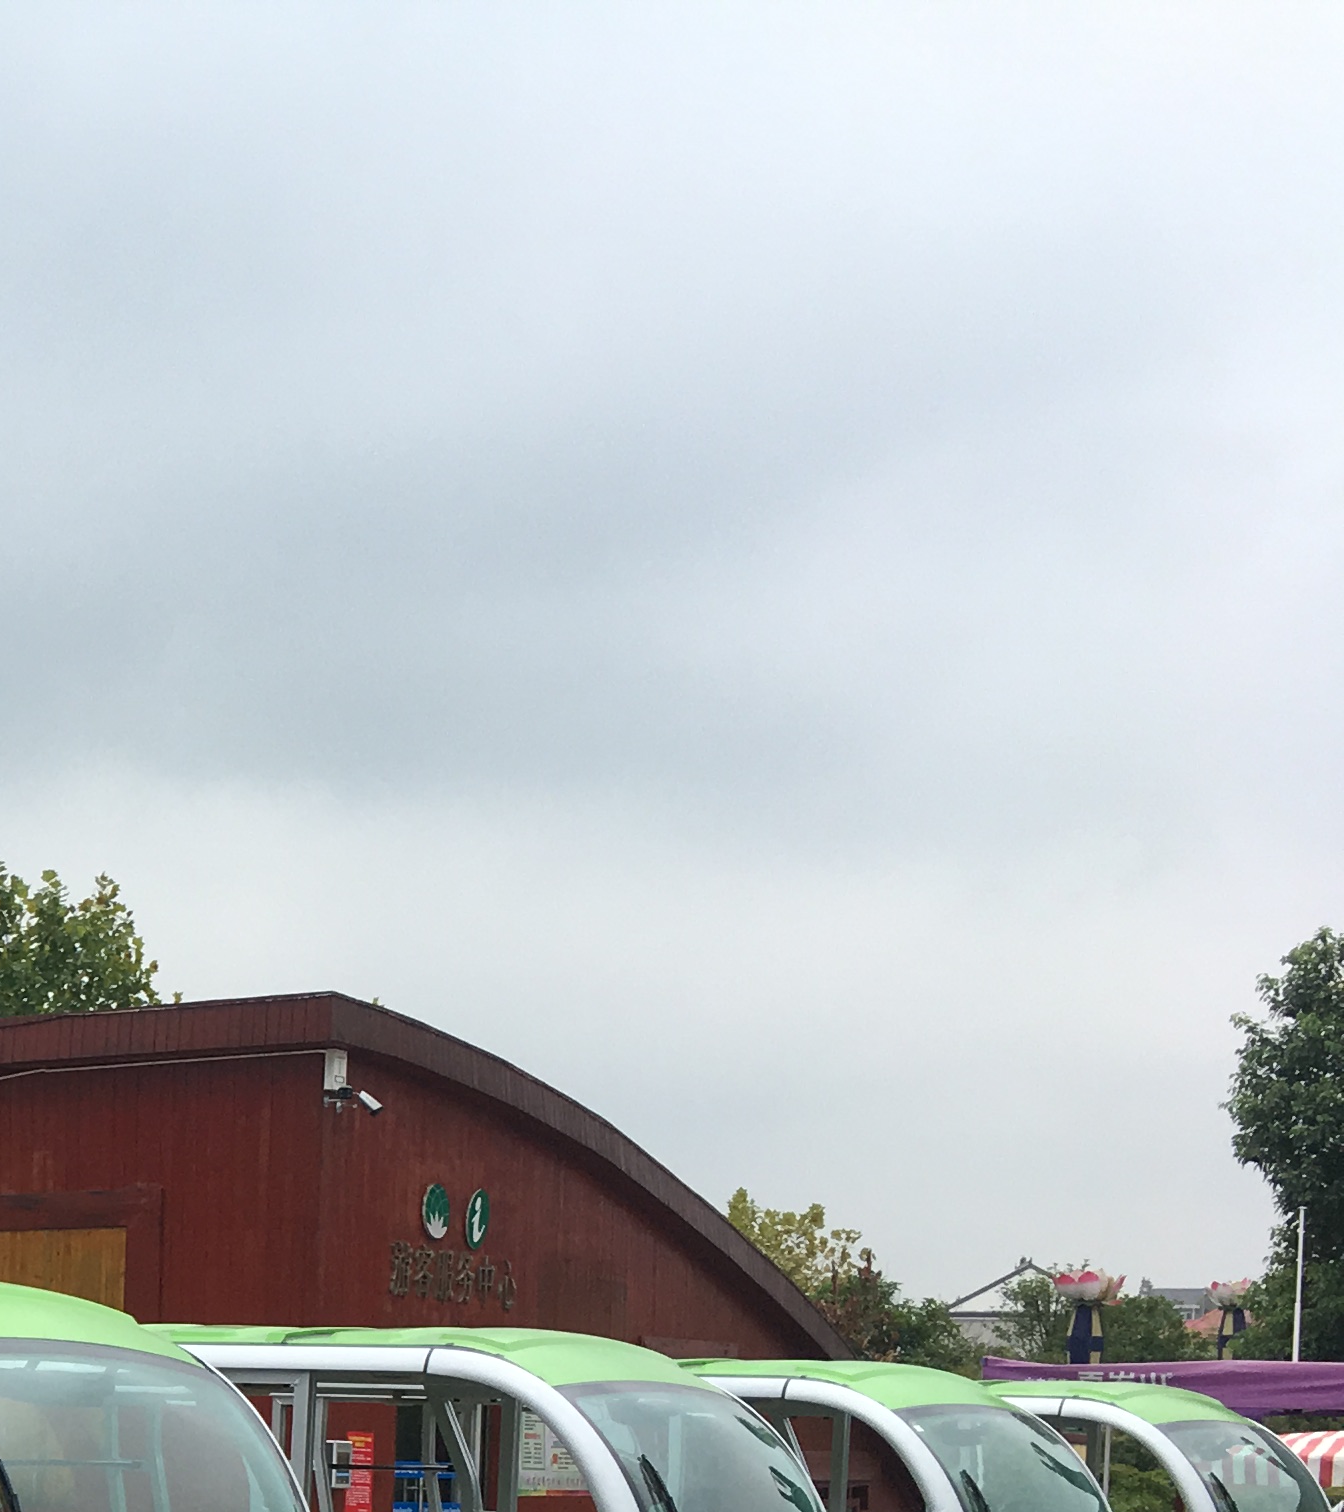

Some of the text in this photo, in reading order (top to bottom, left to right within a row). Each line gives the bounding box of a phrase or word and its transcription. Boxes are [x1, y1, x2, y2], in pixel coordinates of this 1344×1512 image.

[389, 1241, 517, 1312] 游客服务中心
